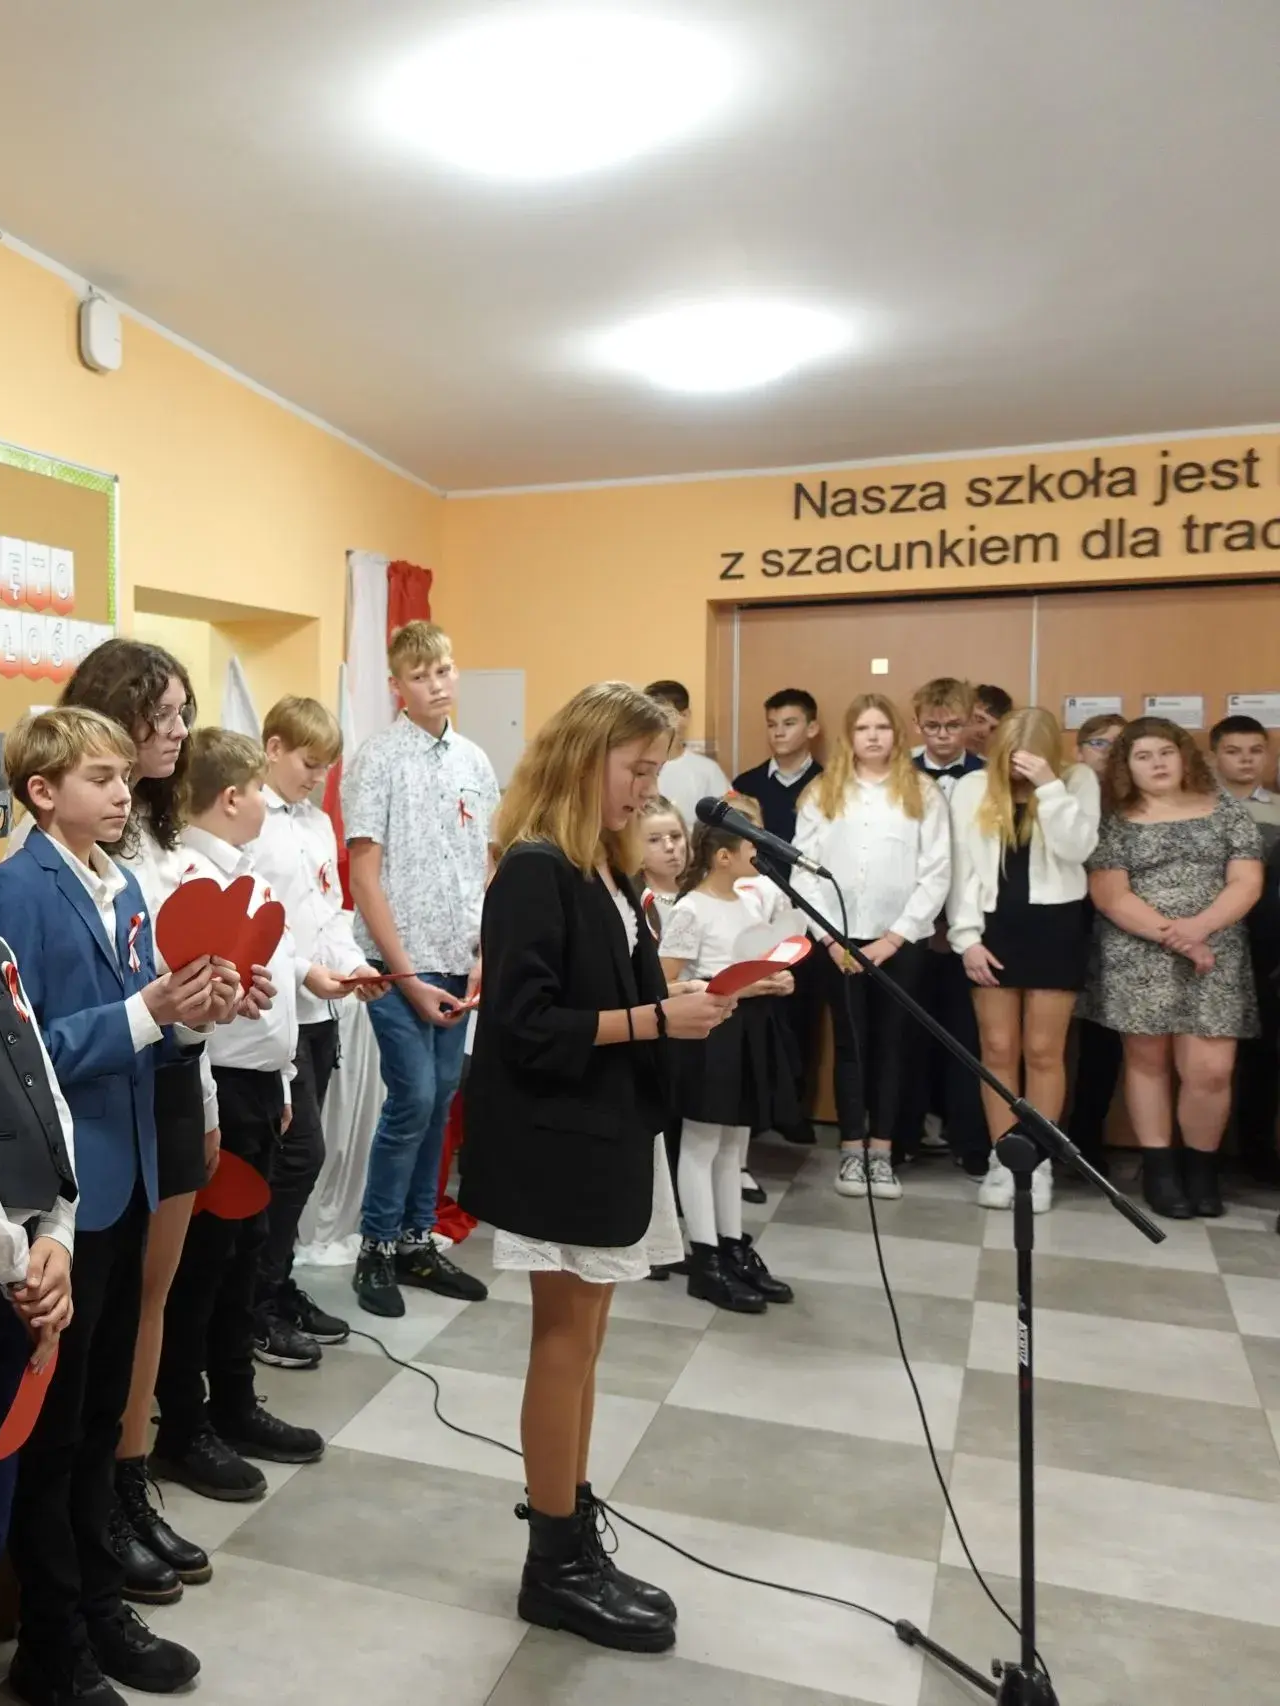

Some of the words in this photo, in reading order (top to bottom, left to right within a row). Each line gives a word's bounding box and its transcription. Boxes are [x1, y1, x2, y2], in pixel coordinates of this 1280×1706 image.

[793, 480, 947, 520] Nasza
[965, 457, 1137, 507] szkoła
[1153, 447, 1261, 506] jest
[719, 551, 745, 580] z
[760, 524, 1059, 578] szacunkiem
[1081, 518, 1161, 560] dla
